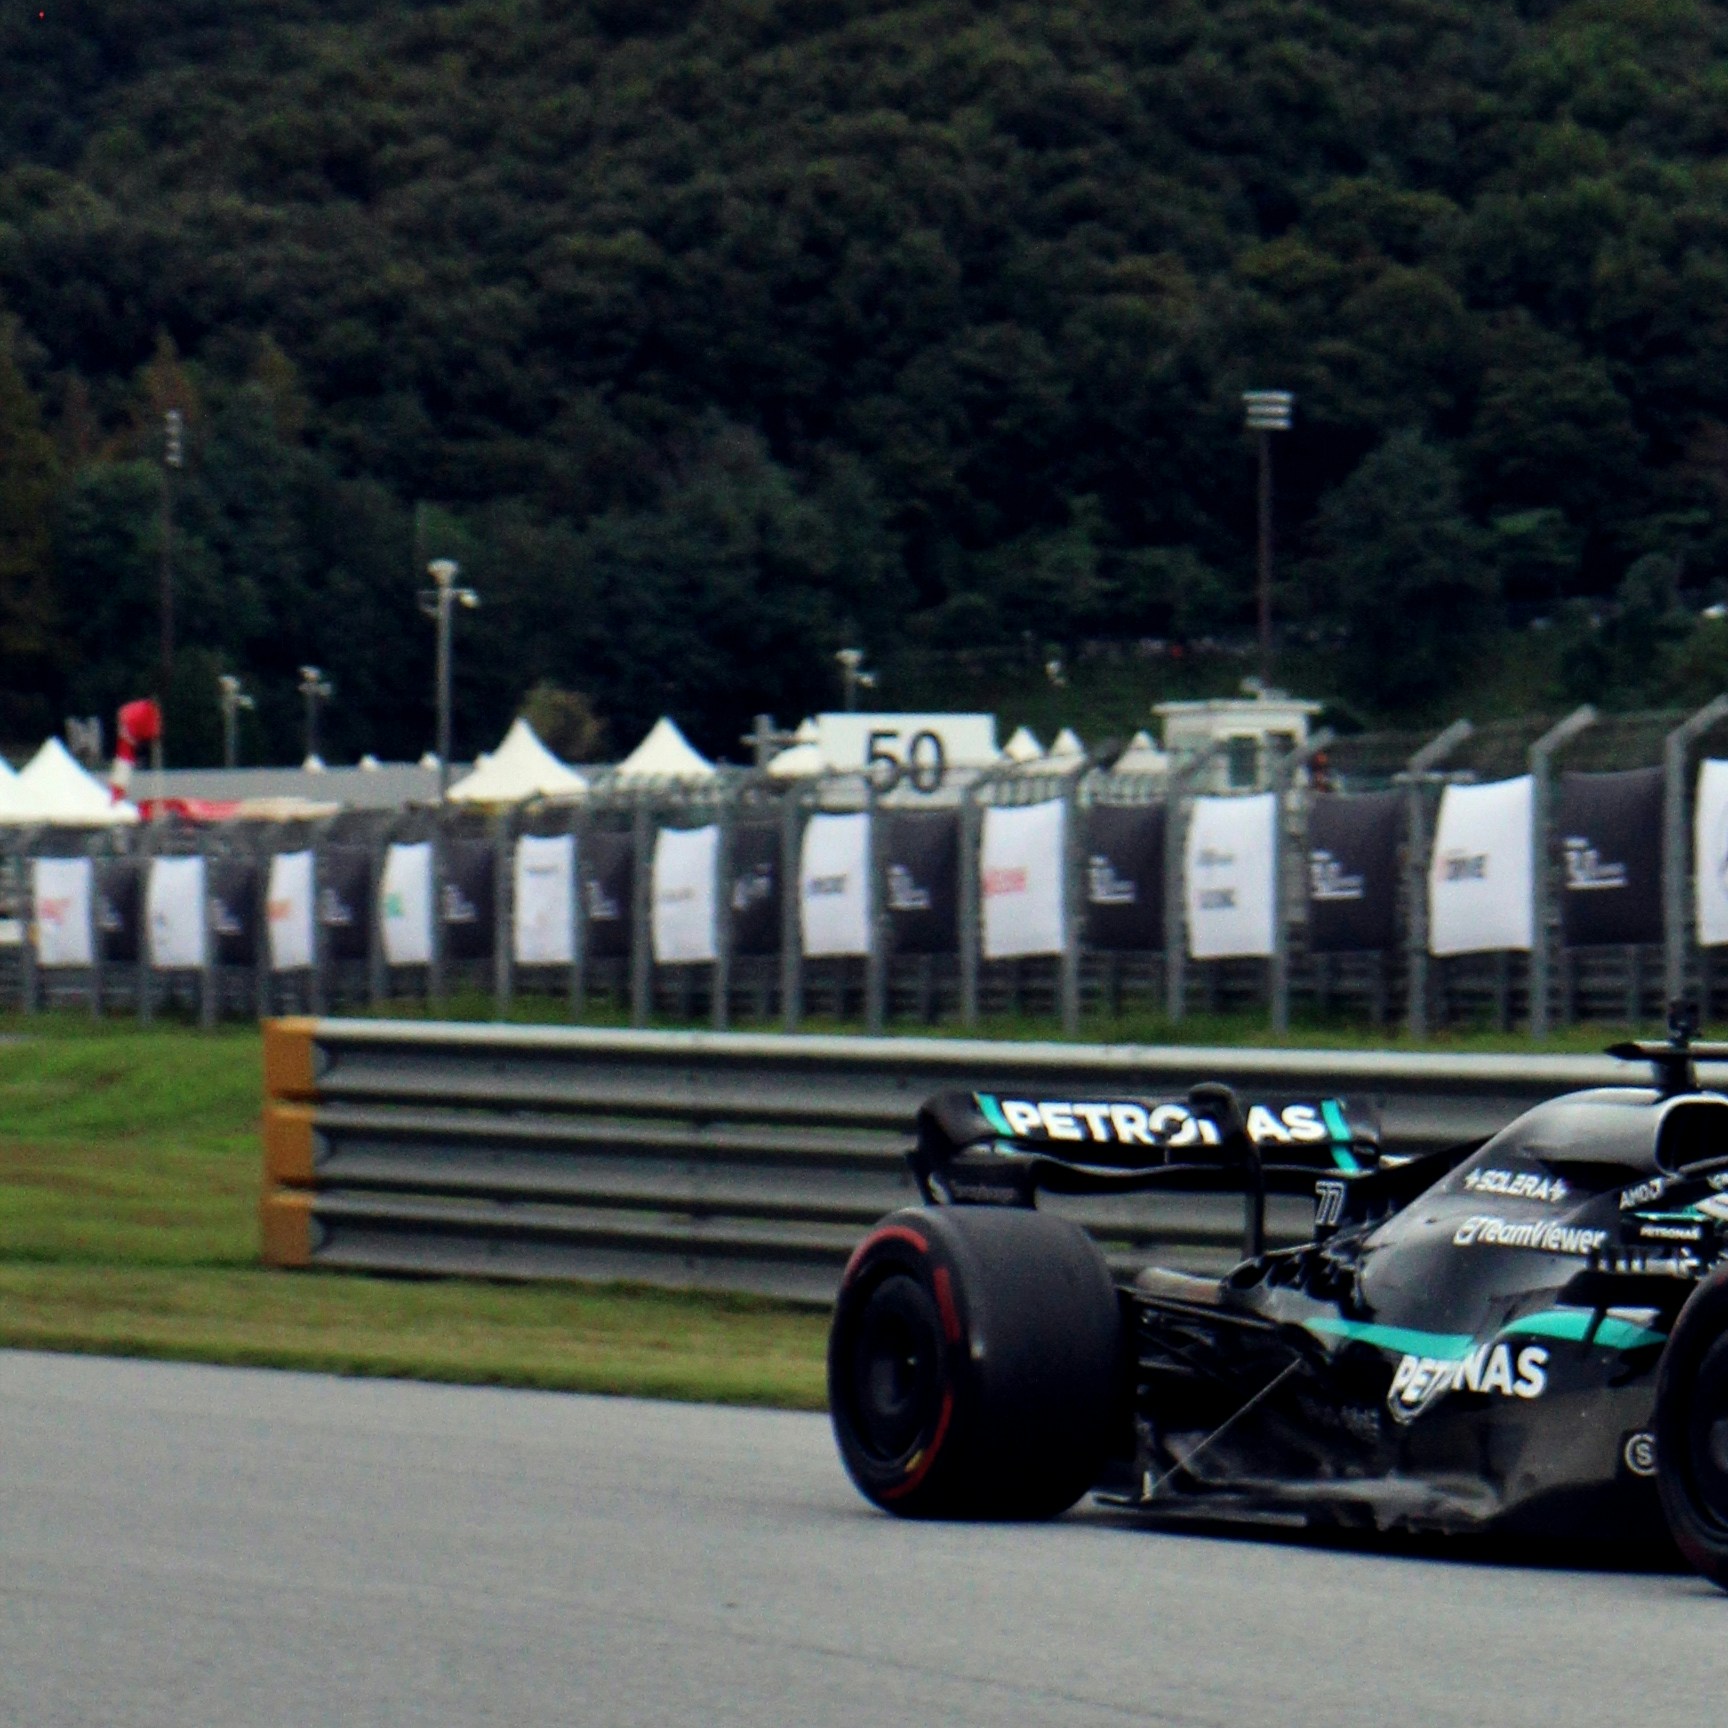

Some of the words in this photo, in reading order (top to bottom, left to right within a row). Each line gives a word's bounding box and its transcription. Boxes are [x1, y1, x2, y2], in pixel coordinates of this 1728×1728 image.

[866, 729, 944, 794] 50
[1478, 1170, 1550, 1200] SOLERA
[1478, 1220, 1606, 1254] TeamViewer
